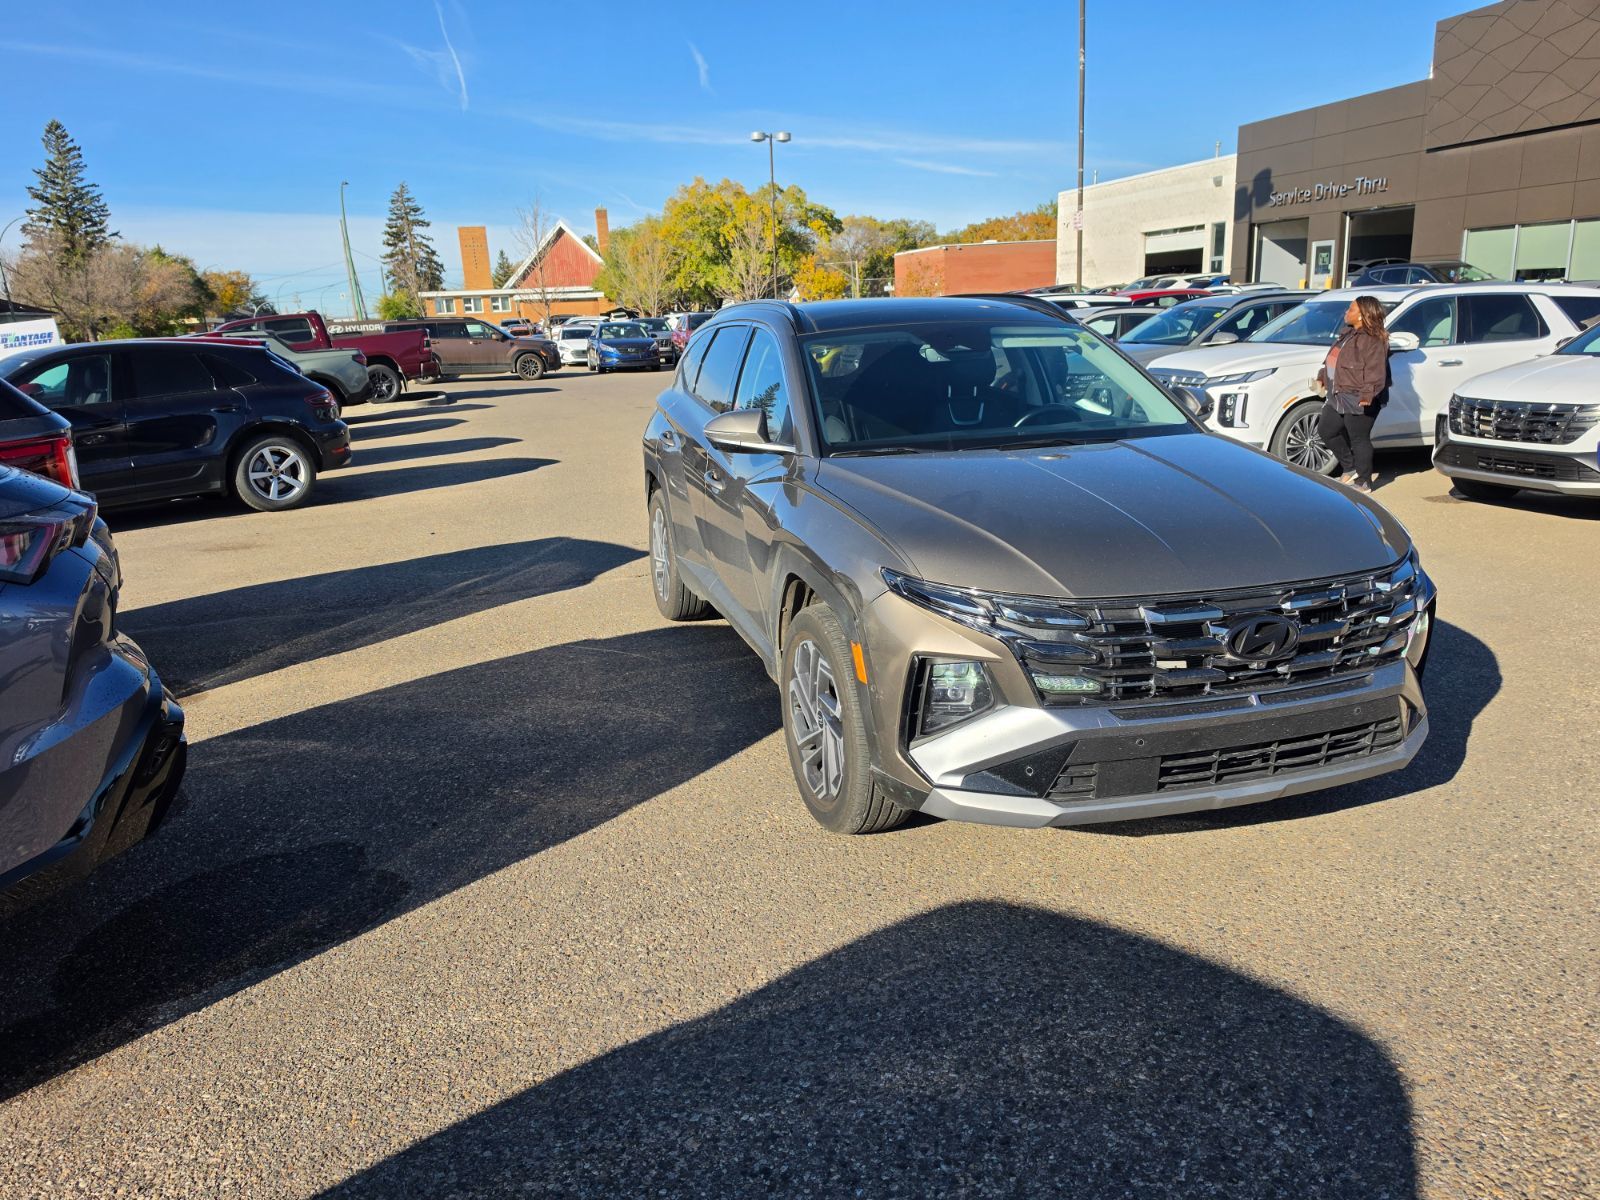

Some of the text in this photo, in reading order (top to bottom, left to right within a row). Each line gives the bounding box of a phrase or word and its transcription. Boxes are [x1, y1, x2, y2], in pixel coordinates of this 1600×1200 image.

[1270, 177, 1388, 207] Service Drive-Thru
[3, 341, 27, 349] SALES
